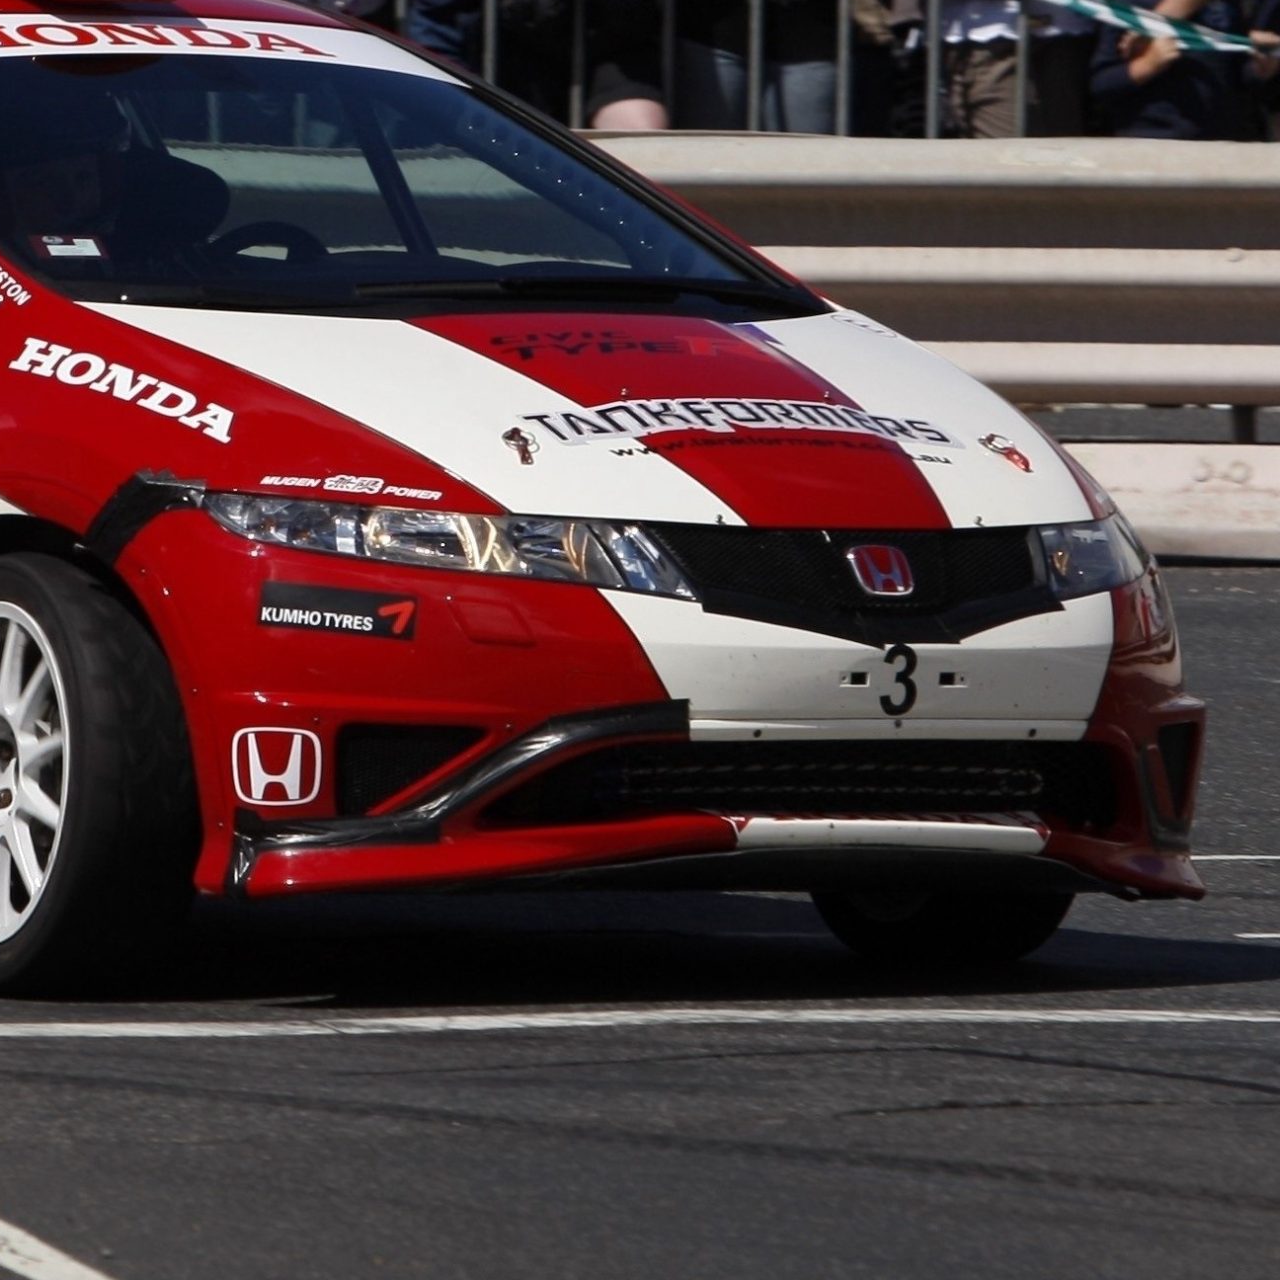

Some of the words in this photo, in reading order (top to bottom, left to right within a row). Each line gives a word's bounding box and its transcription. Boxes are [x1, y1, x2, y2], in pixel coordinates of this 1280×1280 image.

[8, 337, 235, 445] HONDA
[523, 400, 950, 443] TANKFORMERS
[259, 475, 321, 488] MUGEN
[382, 485, 443, 501] POWER
[260, 606, 321, 626] KUMHO
[322, 611, 374, 632] TYRES
[879, 641, 918, 717] 3
